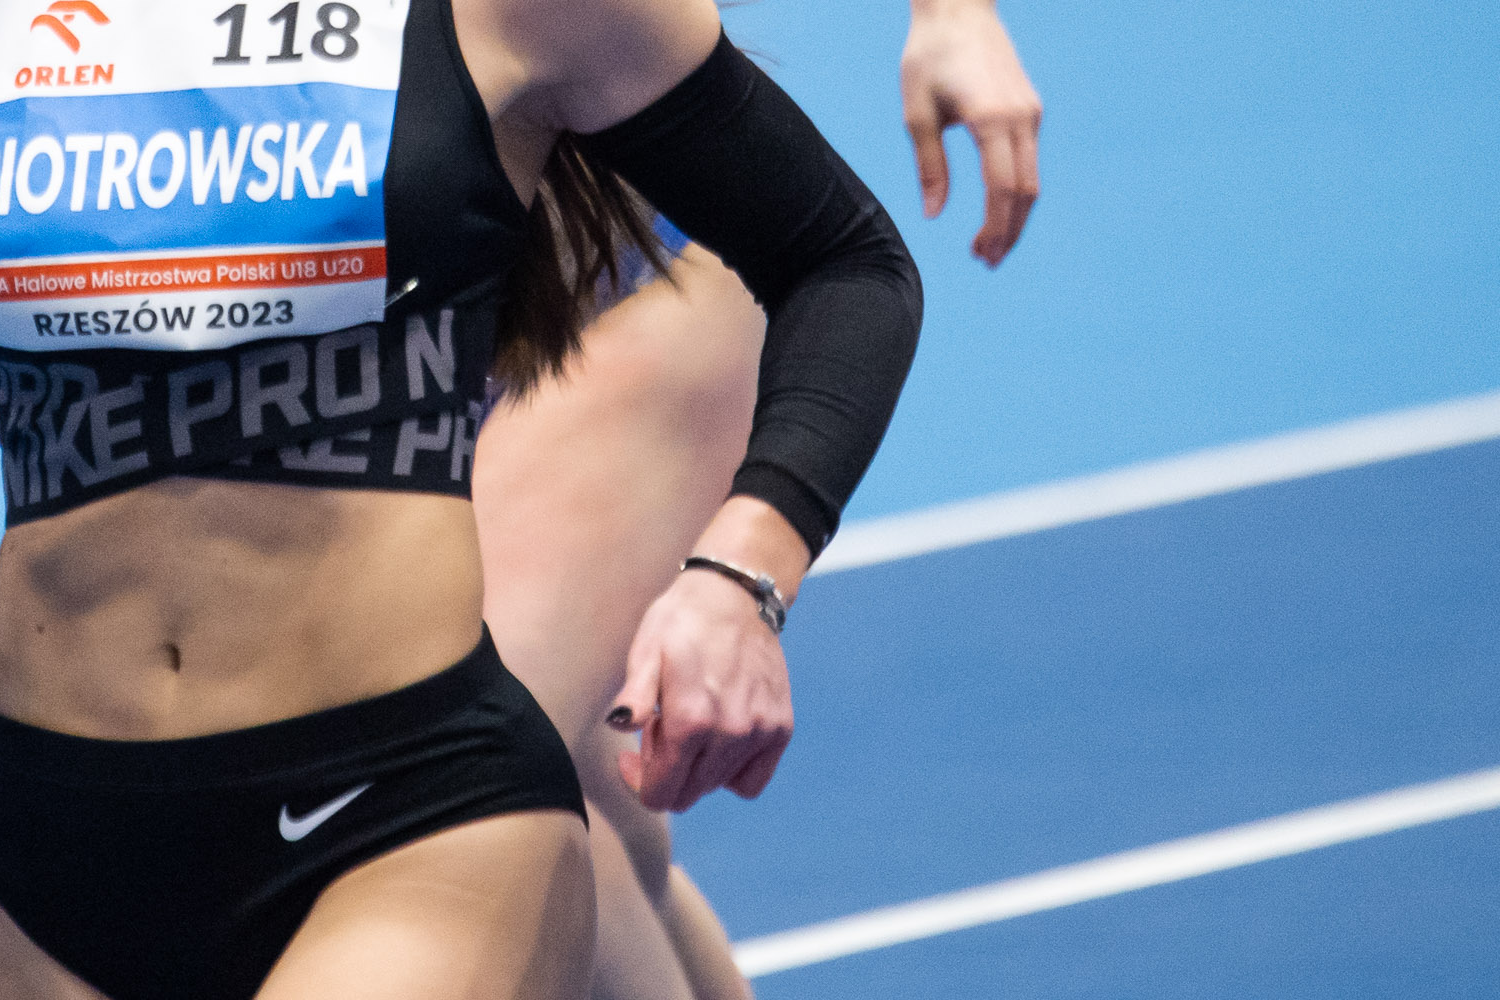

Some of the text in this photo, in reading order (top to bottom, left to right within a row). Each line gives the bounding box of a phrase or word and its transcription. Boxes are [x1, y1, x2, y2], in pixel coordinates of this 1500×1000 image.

[211, 1, 361, 66] 118
[14, 63, 115, 89] ORLEN
[14, 274, 86, 294] Halowe
[91, 266, 211, 289] Mistrzostwa
[216, 262, 276, 283] Polski
[280, 259, 317, 280] U18
[322, 256, 364, 278] U20
[33, 299, 294, 337] RZESZÓW 2023
[168, 325, 382, 458] PRO
